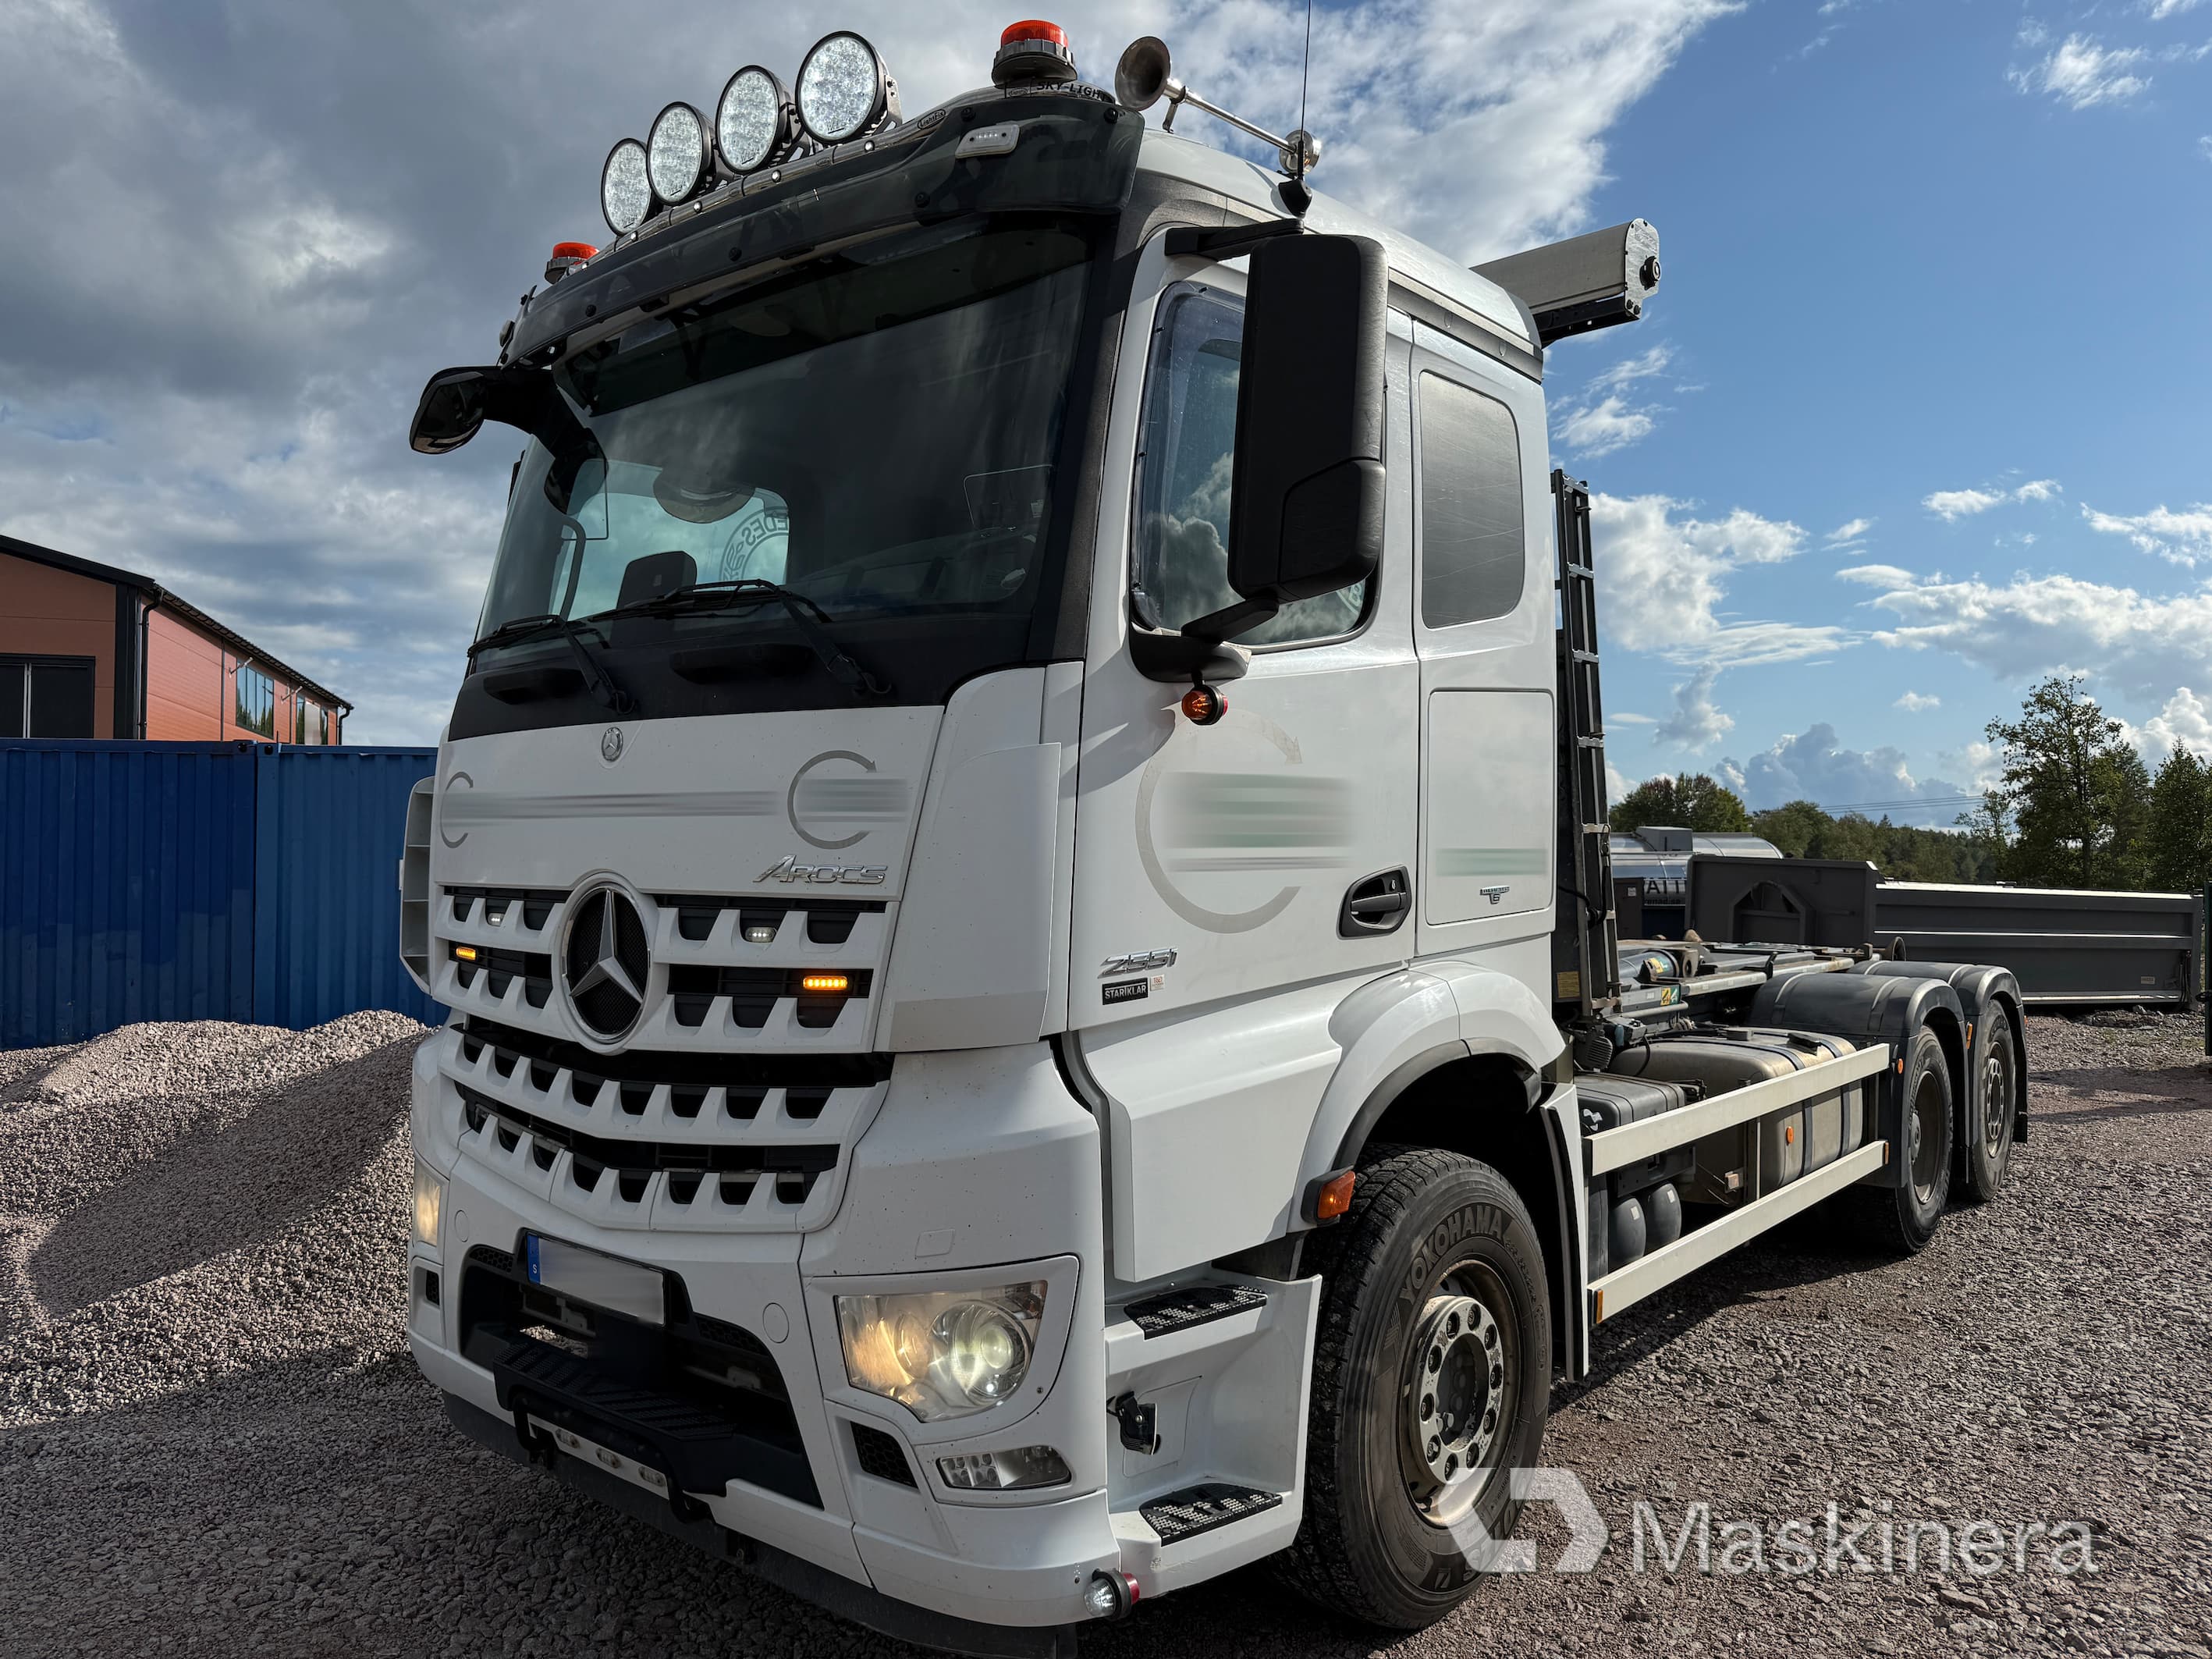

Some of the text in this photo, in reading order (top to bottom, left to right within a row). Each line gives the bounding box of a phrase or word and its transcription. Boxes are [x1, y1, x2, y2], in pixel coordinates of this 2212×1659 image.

[1097, 947, 1179, 979] 2551
[532, 1263, 538, 1274] S
[1399, 1204, 1504, 1306] YOKOHAMA
